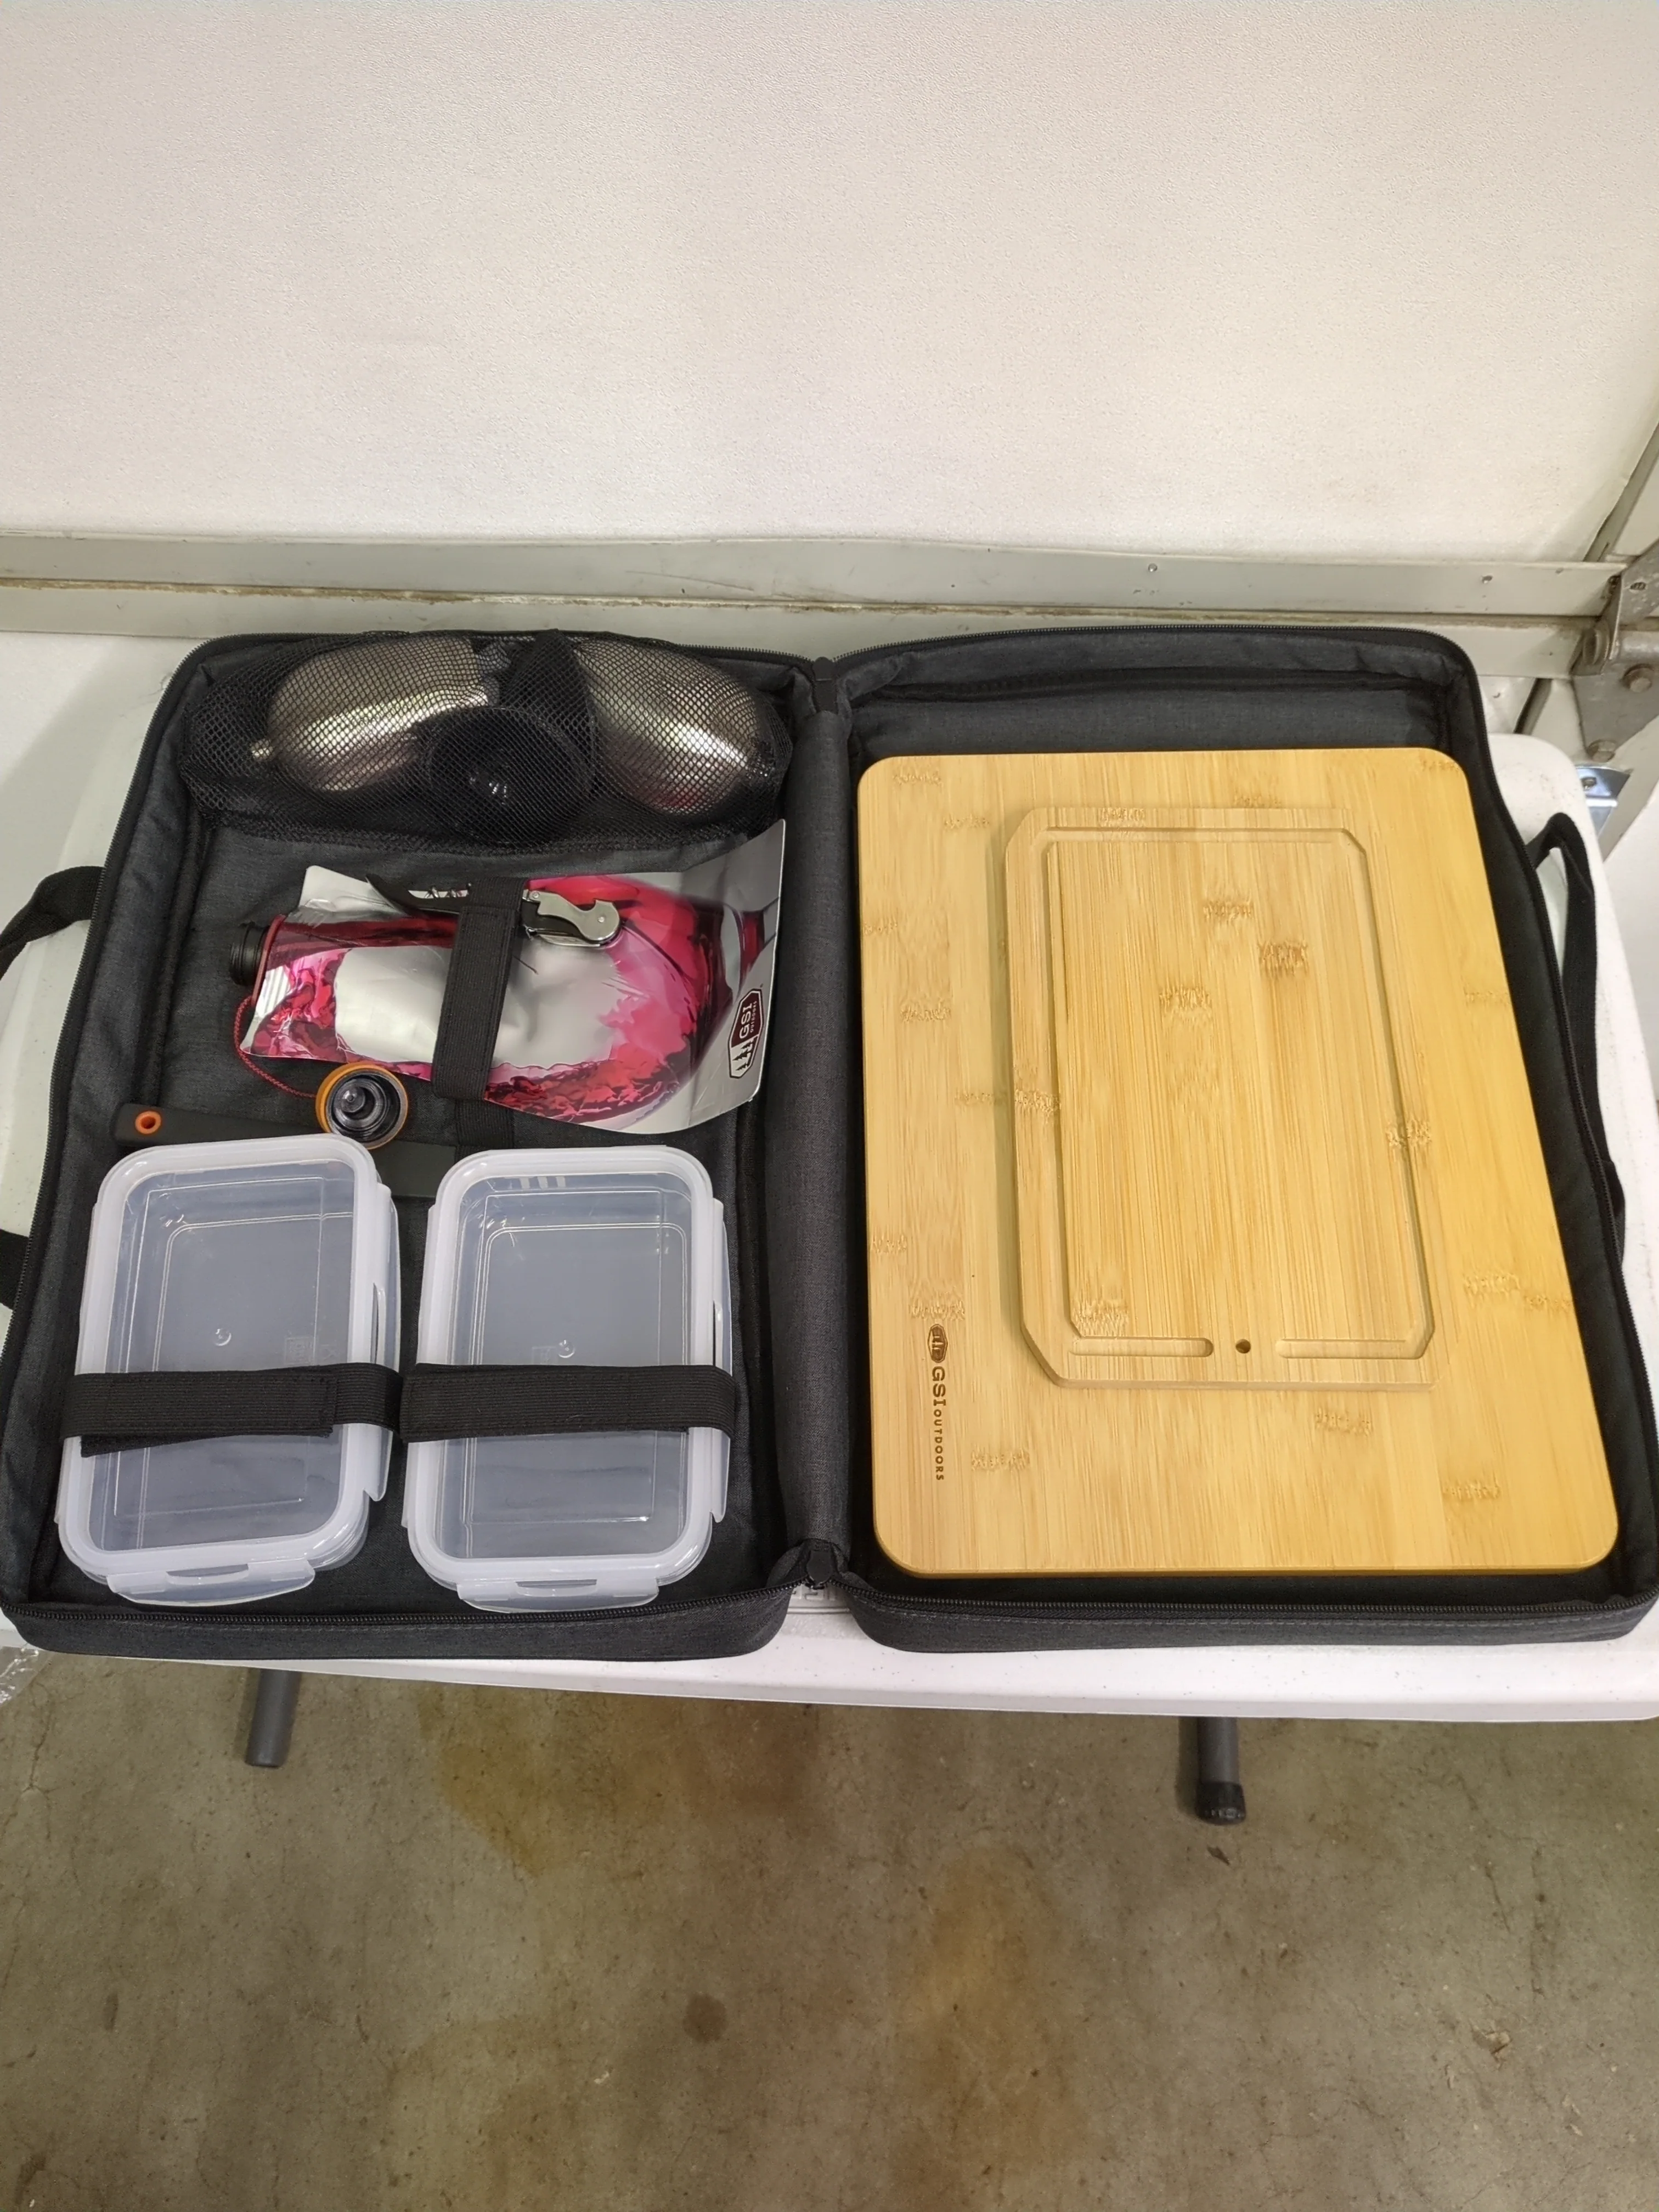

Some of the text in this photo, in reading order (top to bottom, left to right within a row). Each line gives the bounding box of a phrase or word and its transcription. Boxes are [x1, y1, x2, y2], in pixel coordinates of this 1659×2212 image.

[740, 1003, 752, 1039] GSI
[932, 1366, 946, 1480] GSI OUTDOORS
